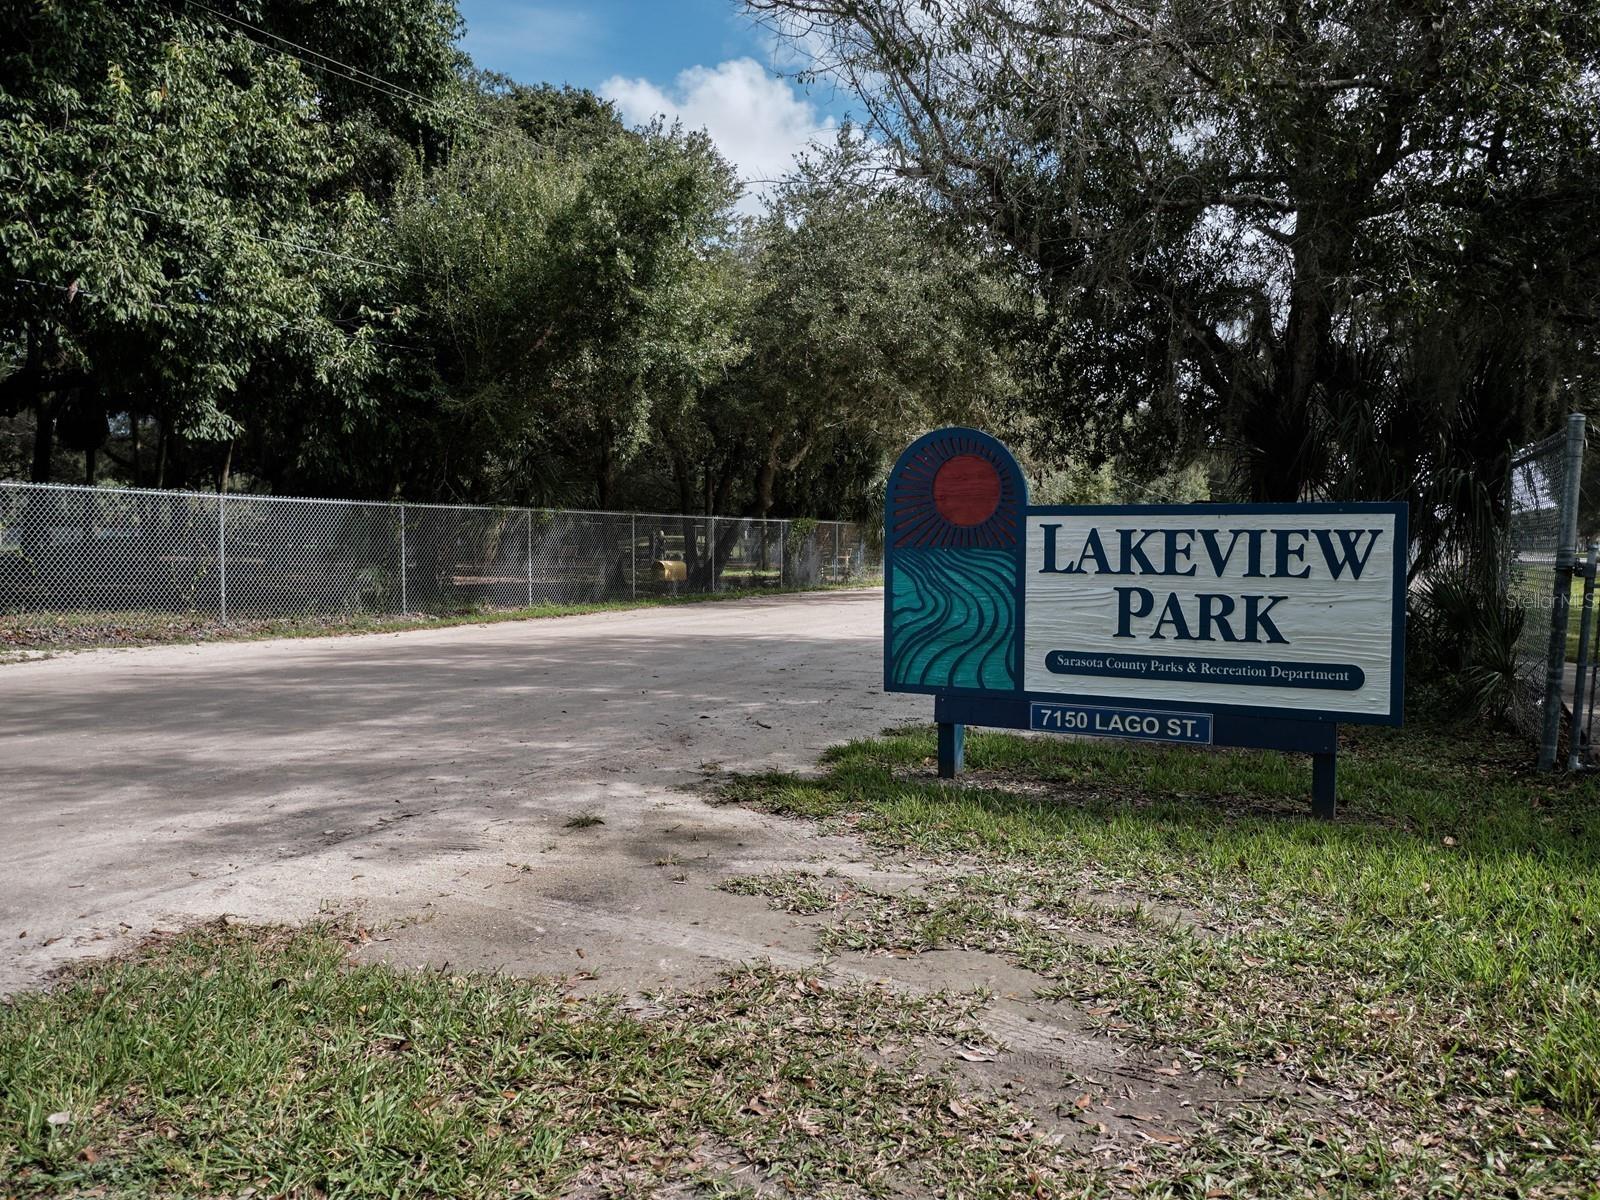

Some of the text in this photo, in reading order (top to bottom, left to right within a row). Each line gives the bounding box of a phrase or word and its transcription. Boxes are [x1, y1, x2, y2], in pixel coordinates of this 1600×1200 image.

[1038, 523, 1384, 581] LAKEVIEW
[1112, 586, 1290, 645] PARK
[1057, 654, 1350, 682] Sarasota County Parks & Recreation Department
[1040, 709, 1200, 738] 7150 LAGO ST.
